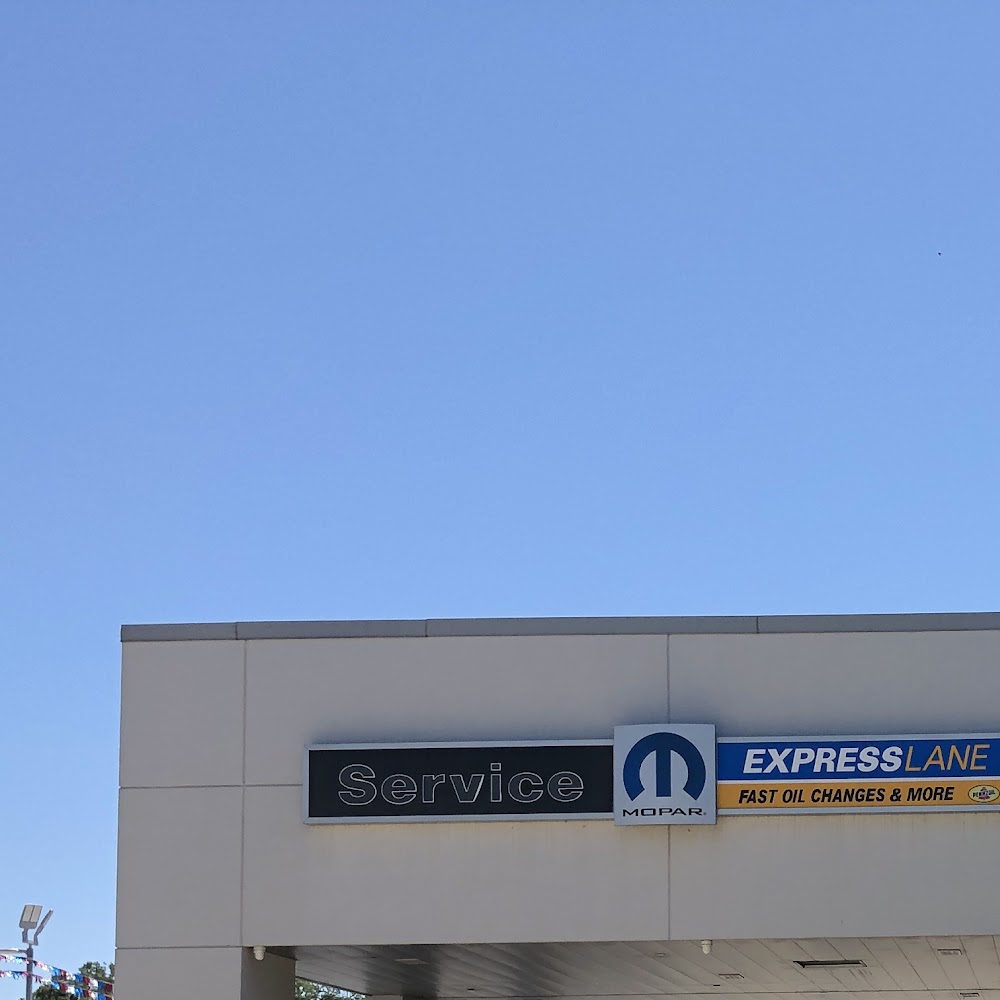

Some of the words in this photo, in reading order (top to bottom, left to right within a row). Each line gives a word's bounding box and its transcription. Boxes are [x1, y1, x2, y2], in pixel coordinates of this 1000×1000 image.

[743, 744, 990, 774] EXPRESSLANE
[338, 762, 584, 805] Service
[738, 789, 778, 804] FAST
[782, 789, 806, 803] OIL
[811, 788, 886, 803] CHANGES
[890, 788, 902, 802] &
[906, 787, 955, 802] MORE
[622, 808, 703, 817] MOPAR
